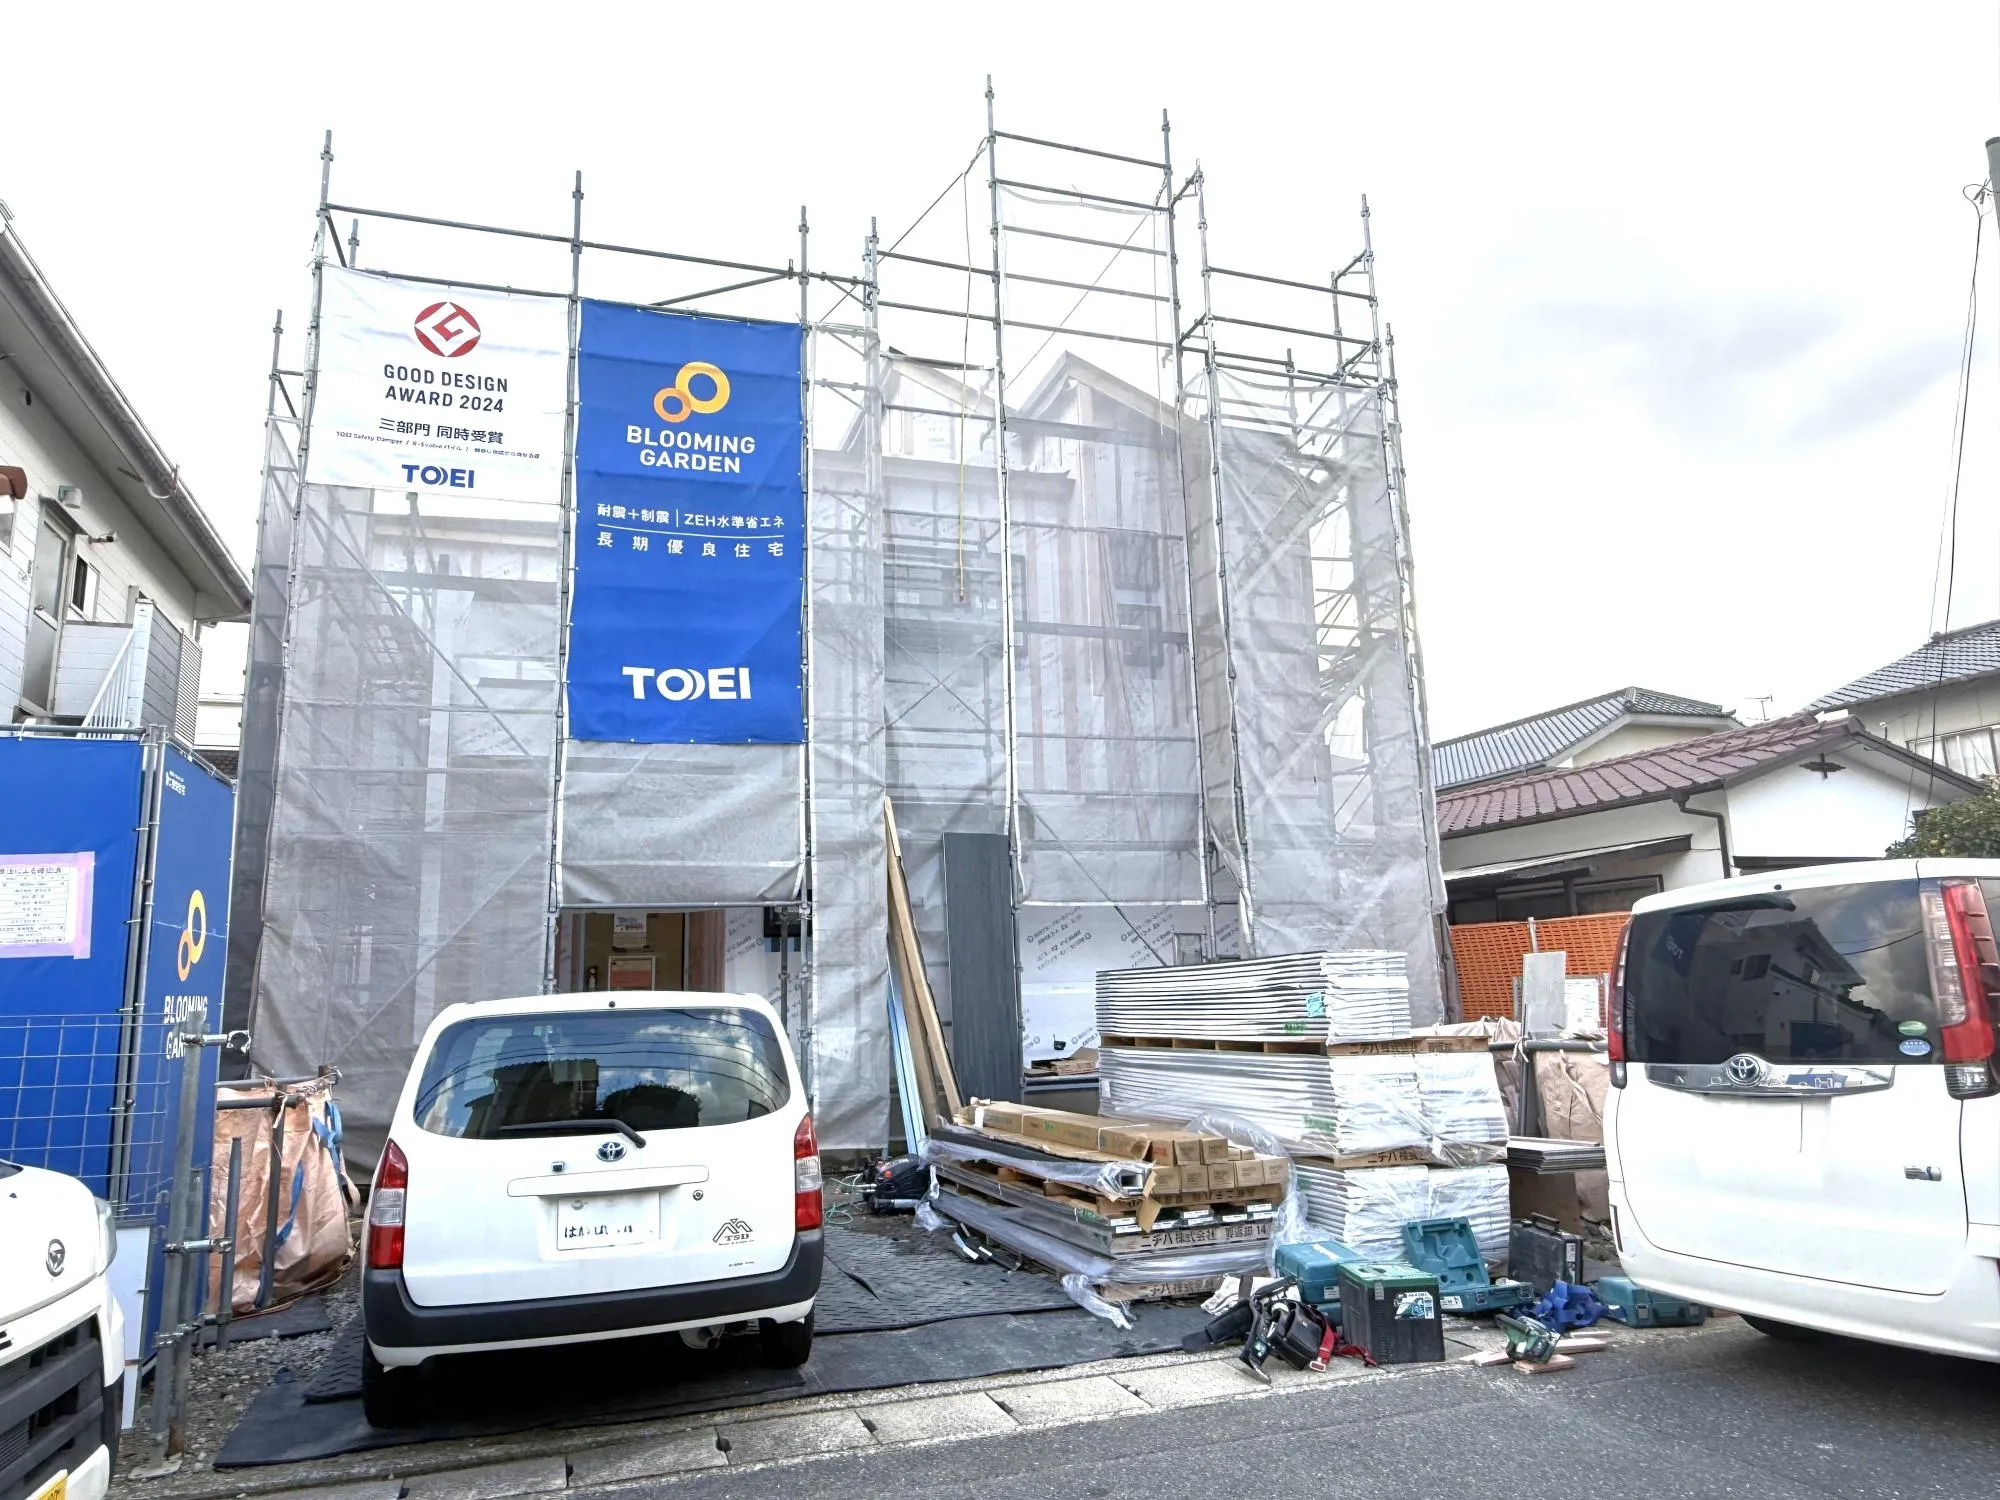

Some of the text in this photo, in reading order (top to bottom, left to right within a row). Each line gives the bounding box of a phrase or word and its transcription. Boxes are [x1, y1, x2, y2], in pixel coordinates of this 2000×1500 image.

[384, 364, 508, 392] GOOD DESIGN
[385, 385, 504, 413] AWARD 2024
[379, 417, 504, 445] 三部門 同時受賞
[626, 425, 756, 454] BLOOMING
[639, 448, 741, 474] GARDEN
[401, 464, 475, 488] TOEI
[684, 513, 785, 529] ZEH水準省エネ
[597, 531, 785, 558] 長期優良住宅
[622, 665, 752, 701] TOEI
